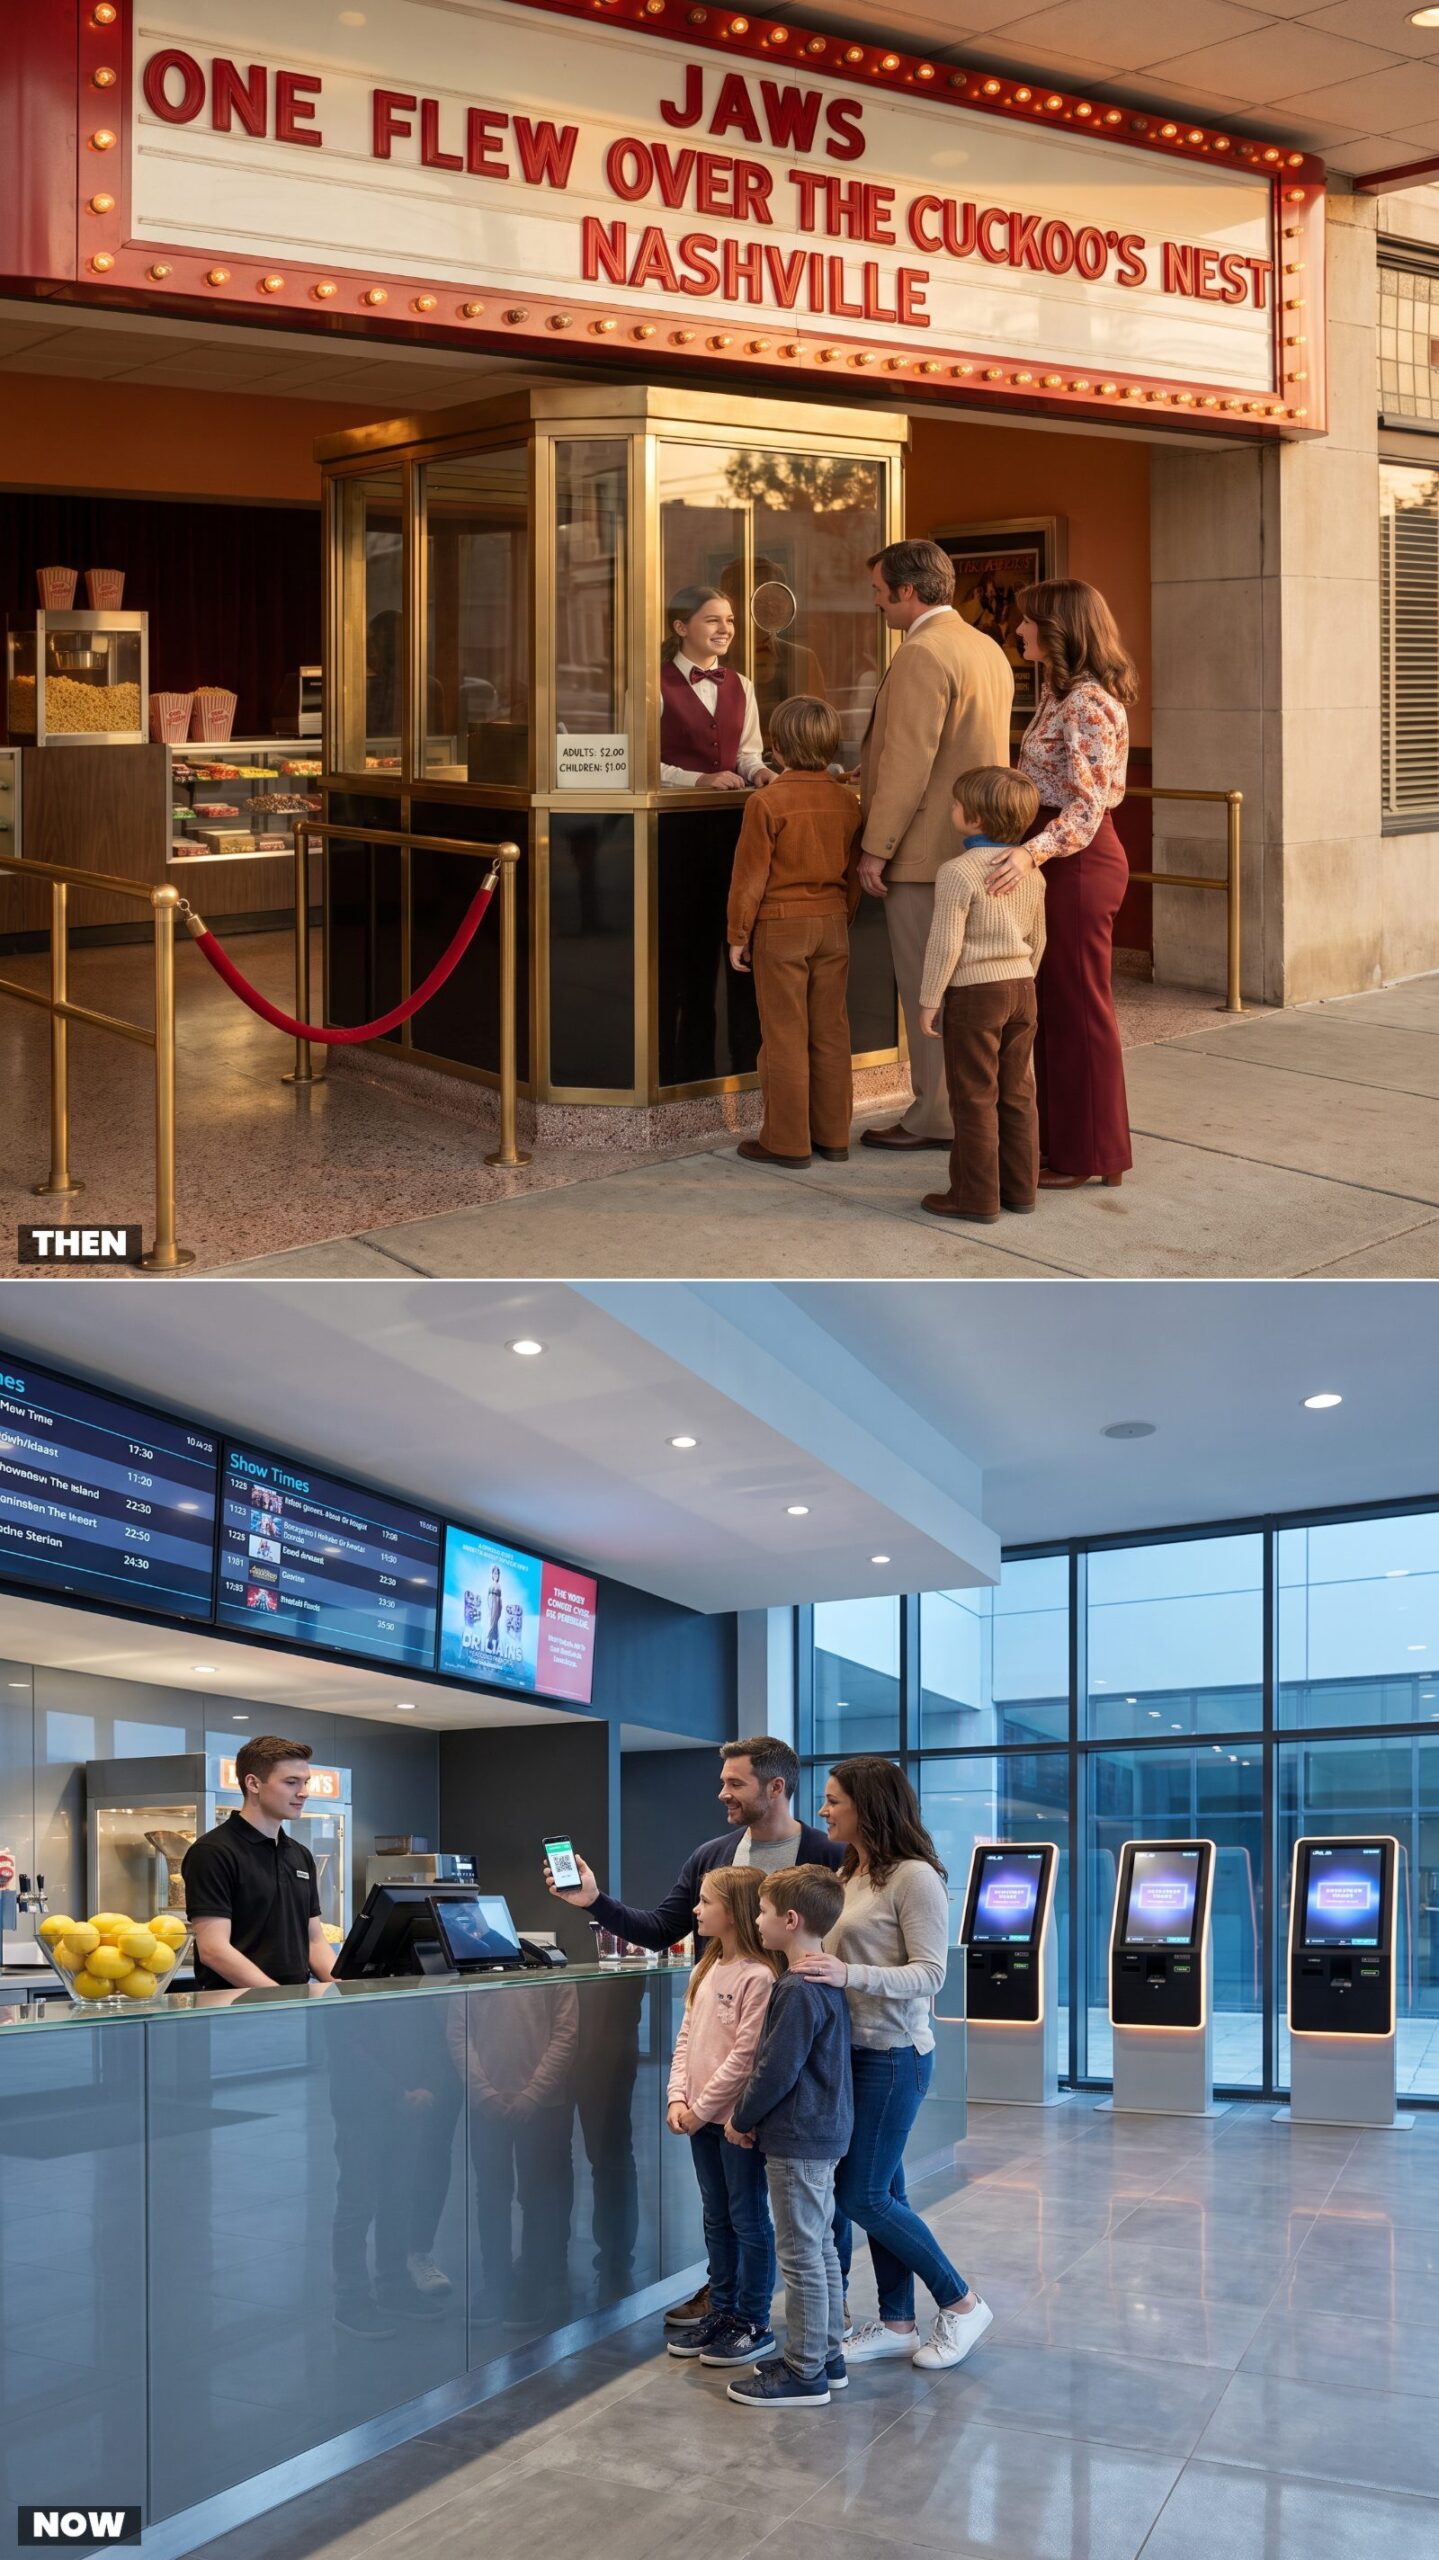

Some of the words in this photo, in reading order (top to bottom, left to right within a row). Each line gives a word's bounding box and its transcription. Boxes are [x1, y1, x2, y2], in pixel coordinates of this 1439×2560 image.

[660, 64, 866, 161] JAWS
[142, 48, 322, 148] ONE
[372, 87, 579, 189] FLEW
[606, 136, 774, 226] OVER
[788, 168, 896, 245] THE
[908, 194, 1146, 287] CUCKOO'S
[1163, 241, 1273, 309] NEST
[582, 215, 932, 327] NASHVILLE
[562, 747, 597, 757] ADULTS:
[600, 747, 625, 757] $2.00
[559, 762, 602, 773] CHILDREN:
[605, 762, 627, 773] $1.00
[128, 1444, 154, 1460] 17:30
[230, 1452, 269, 1479] Show
[271, 1466, 310, 1494] Times
[50, 1476, 69, 1490] The
[125, 1499, 152, 1515] 22:30
[47, 1505, 67, 1520] The
[123, 1555, 150, 1570] 24:30
